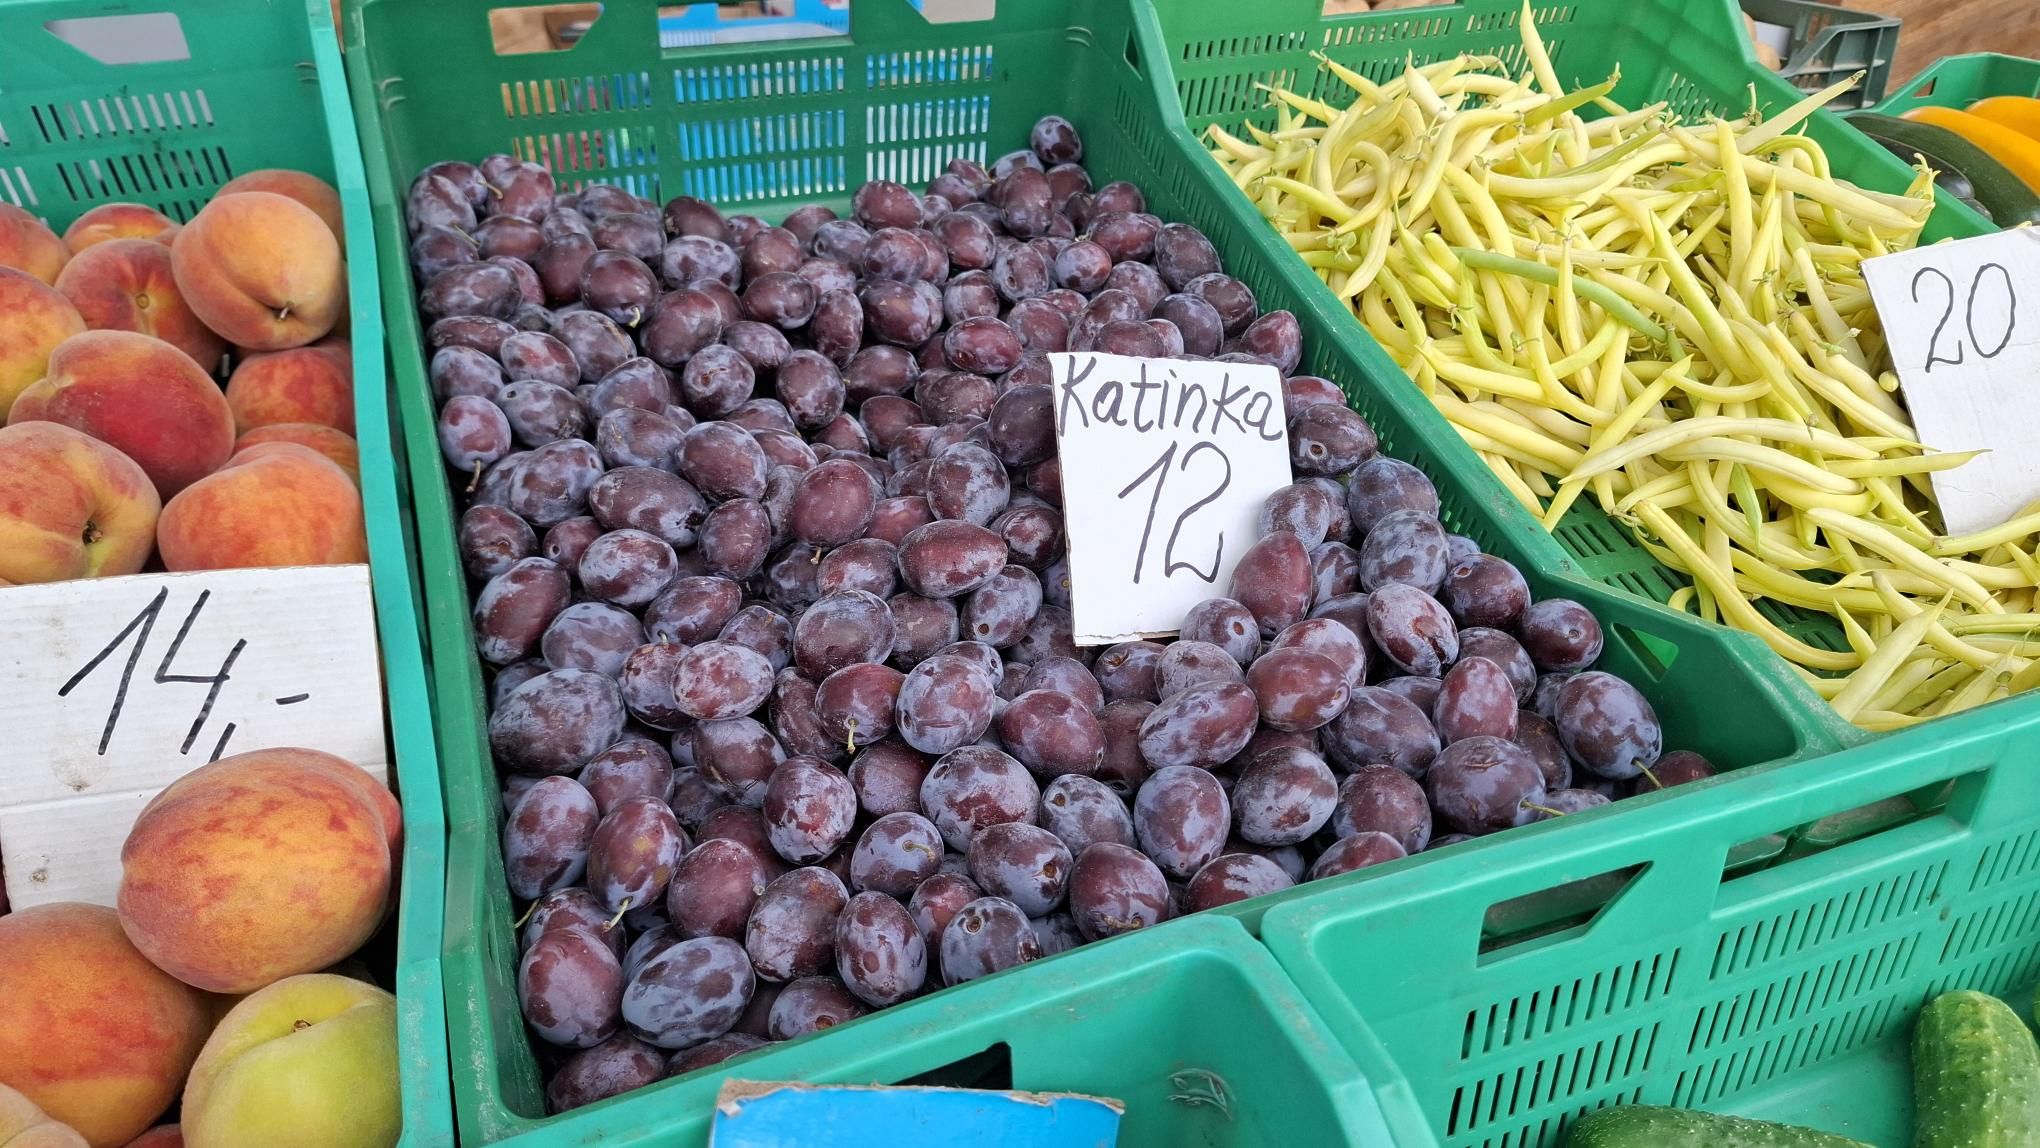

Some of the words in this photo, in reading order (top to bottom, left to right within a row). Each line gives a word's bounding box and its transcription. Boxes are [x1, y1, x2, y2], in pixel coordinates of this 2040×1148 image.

[1911, 263, 2017, 373] 20
[1059, 354, 1283, 441] Katinka
[1117, 440, 1232, 584] 12
